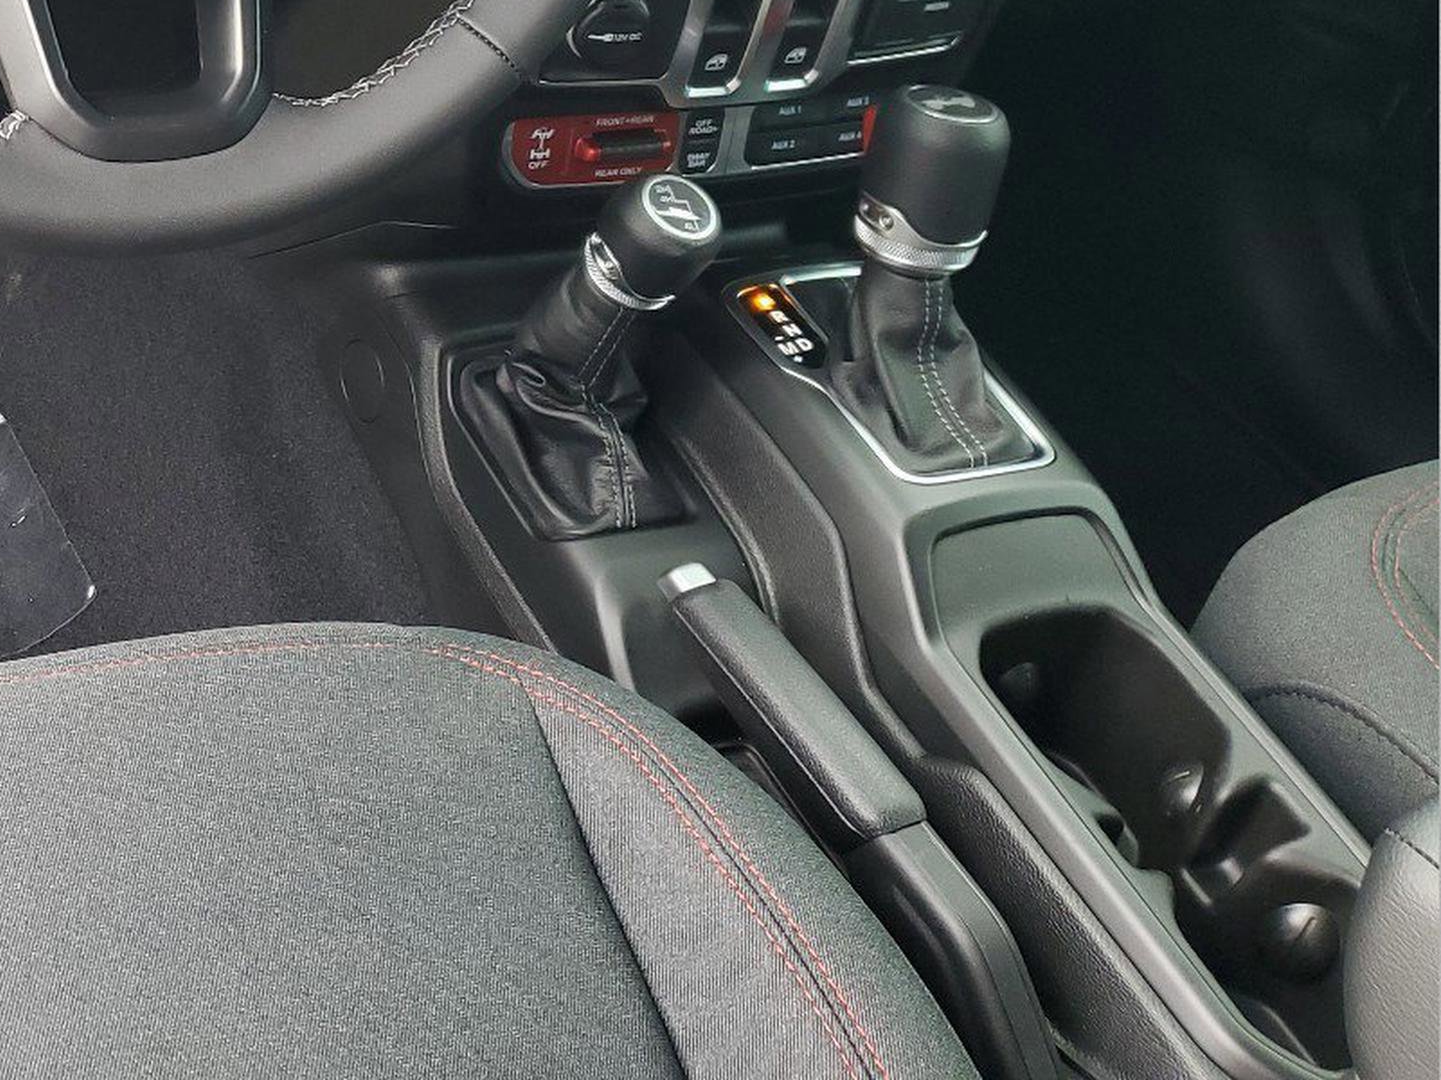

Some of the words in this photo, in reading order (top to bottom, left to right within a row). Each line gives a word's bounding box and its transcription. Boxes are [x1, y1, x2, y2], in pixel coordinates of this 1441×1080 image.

[847, 98, 863, 107] AUX
[779, 106, 796, 116] AUX
[695, 119, 712, 127] OFF
[838, 132, 855, 141] AUX
[771, 141, 789, 150] AUX
[528, 161, 548, 169] OFF
[595, 169, 618, 177] REAR
[619, 166, 642, 176] ONLY
[782, 323, 802, 337] N
[778, 342, 800, 356] M
[795, 337, 814, 352] D
